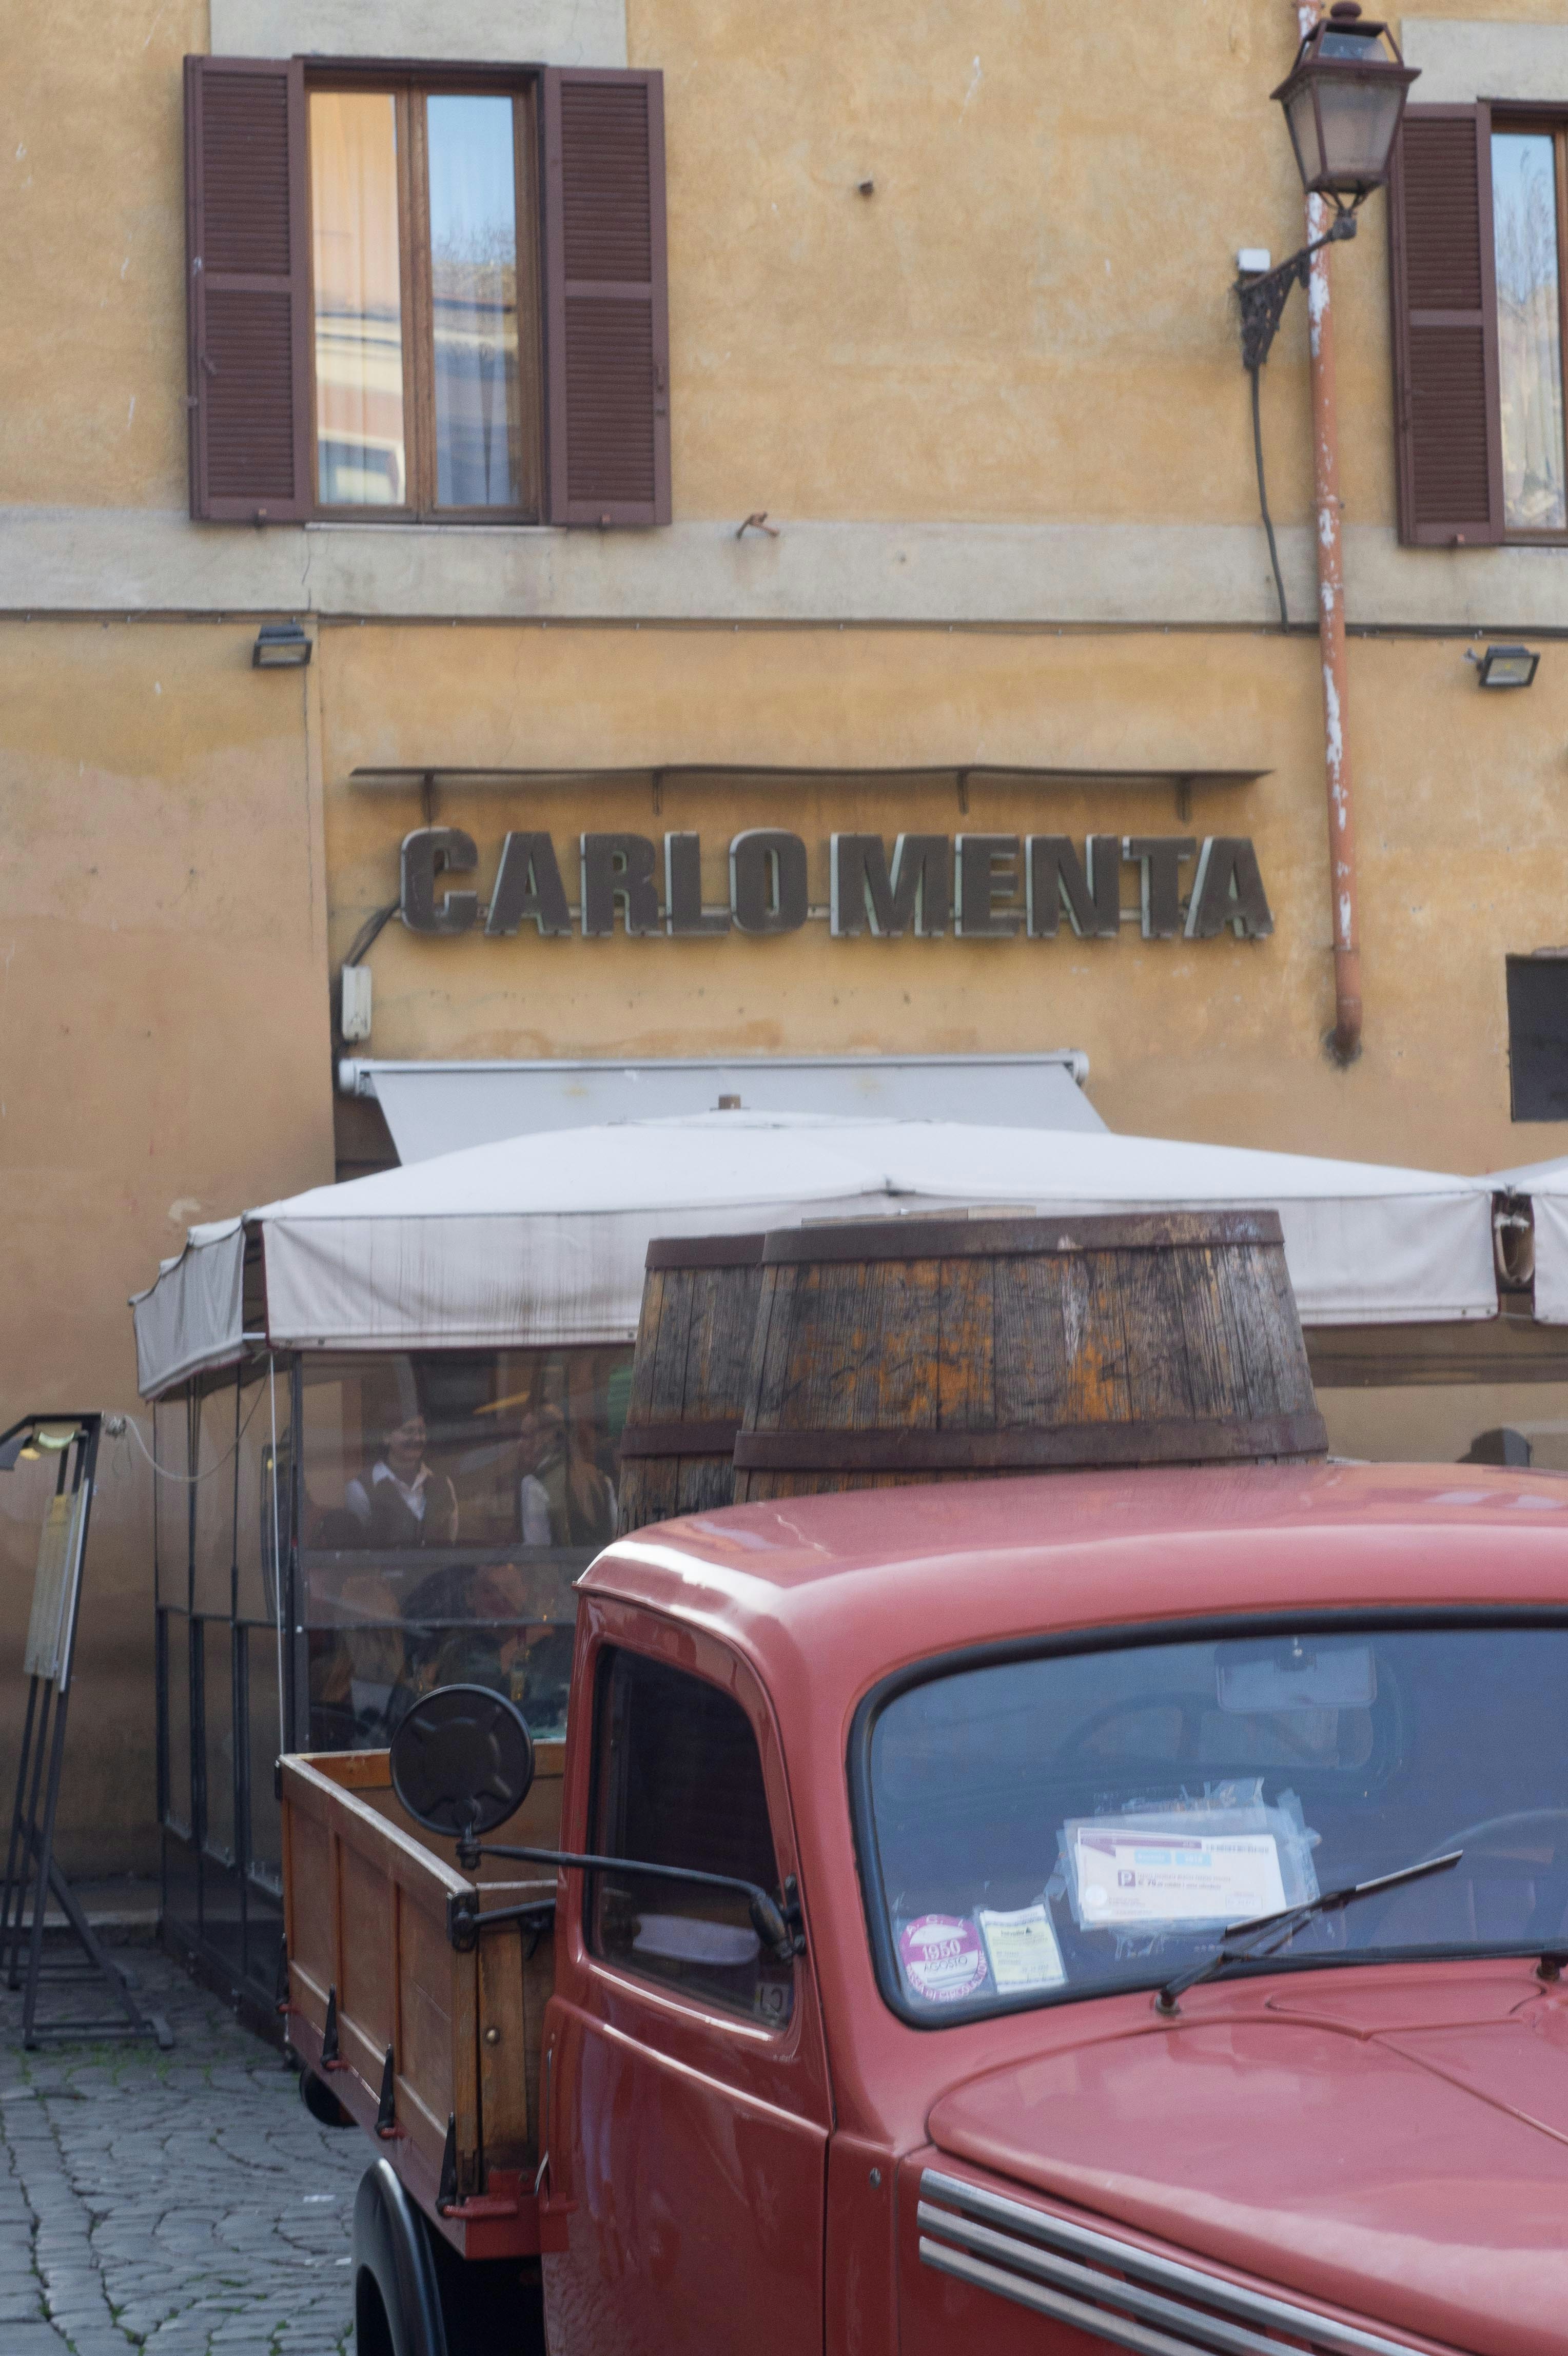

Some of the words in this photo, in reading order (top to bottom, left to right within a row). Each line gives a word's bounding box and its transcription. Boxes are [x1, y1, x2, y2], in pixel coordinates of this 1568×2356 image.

[401, 827, 808, 936] CARLO
[830, 832, 1275, 939] MENTA
[922, 1939, 961, 1961] 1950
[924, 1955, 968, 1972] AGOSTO
